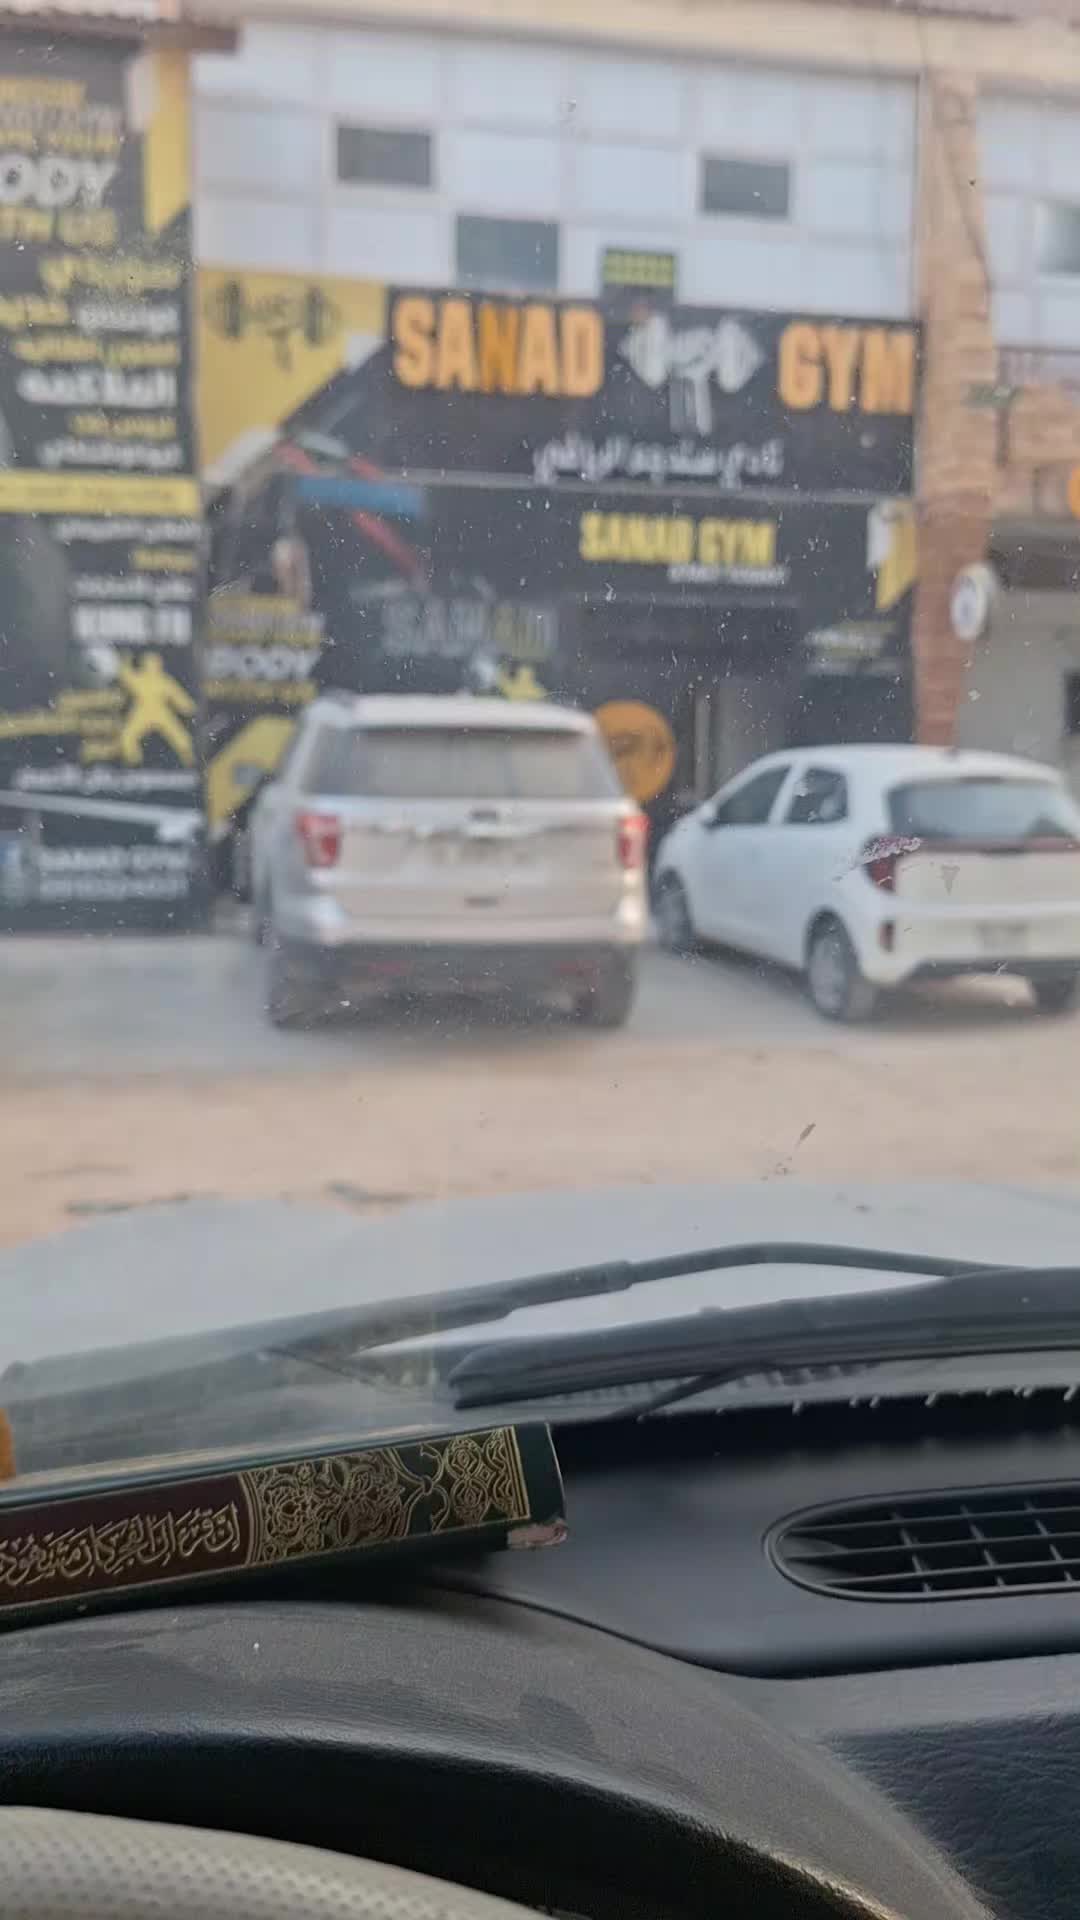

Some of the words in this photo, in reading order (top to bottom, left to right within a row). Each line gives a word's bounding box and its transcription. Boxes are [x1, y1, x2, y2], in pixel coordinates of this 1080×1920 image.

[392, 297, 606, 398] SANAD
[777, 319, 915, 414] GYM
[579, 510, 694, 564] SANAD
[697, 516, 775, 568] GYM
